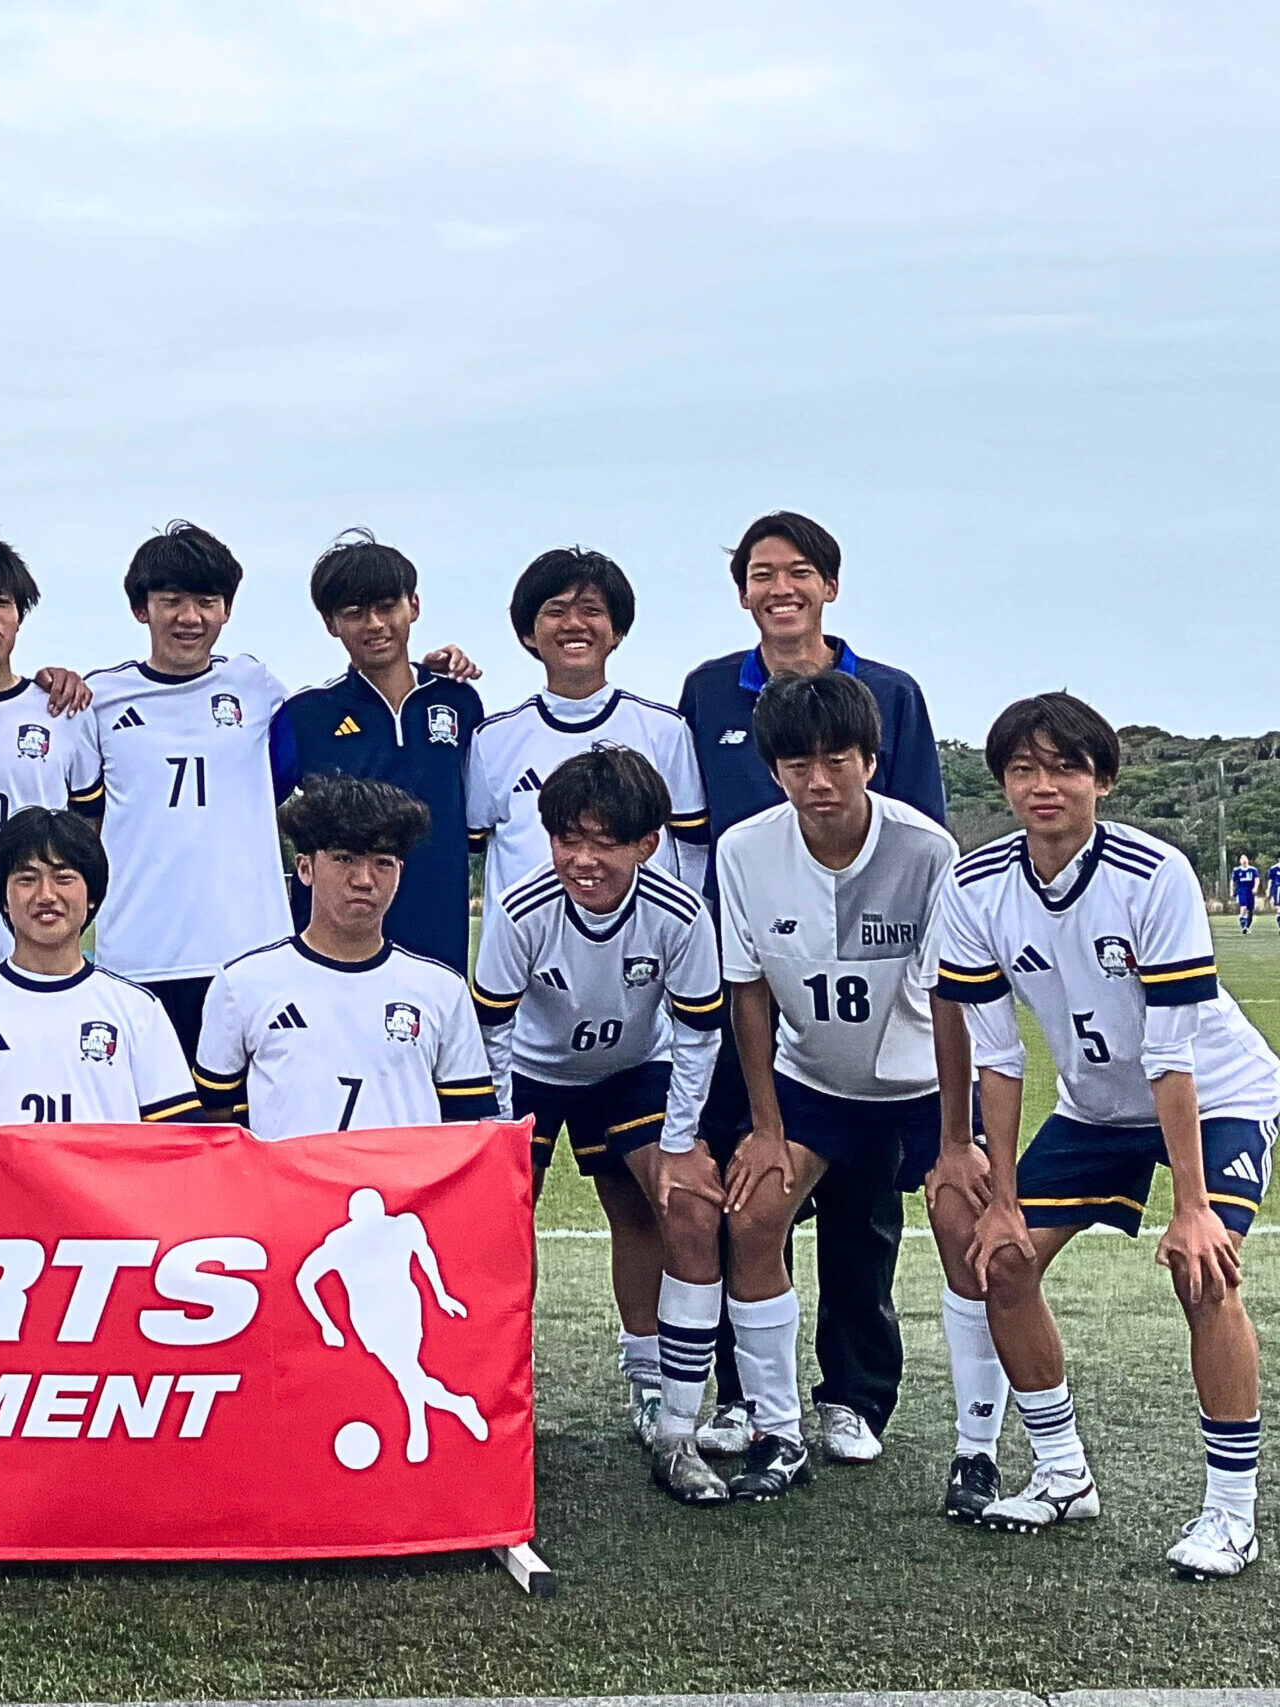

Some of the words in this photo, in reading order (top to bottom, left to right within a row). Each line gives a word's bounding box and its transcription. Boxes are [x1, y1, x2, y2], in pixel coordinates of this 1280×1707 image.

[165, 756, 206, 808] 71
[862, 923, 918, 946] BUNRI
[803, 973, 871, 1024] 18
[570, 1019, 624, 1052] 69
[1072, 1010, 1111, 1064] 5
[337, 1076, 363, 1132] 7
